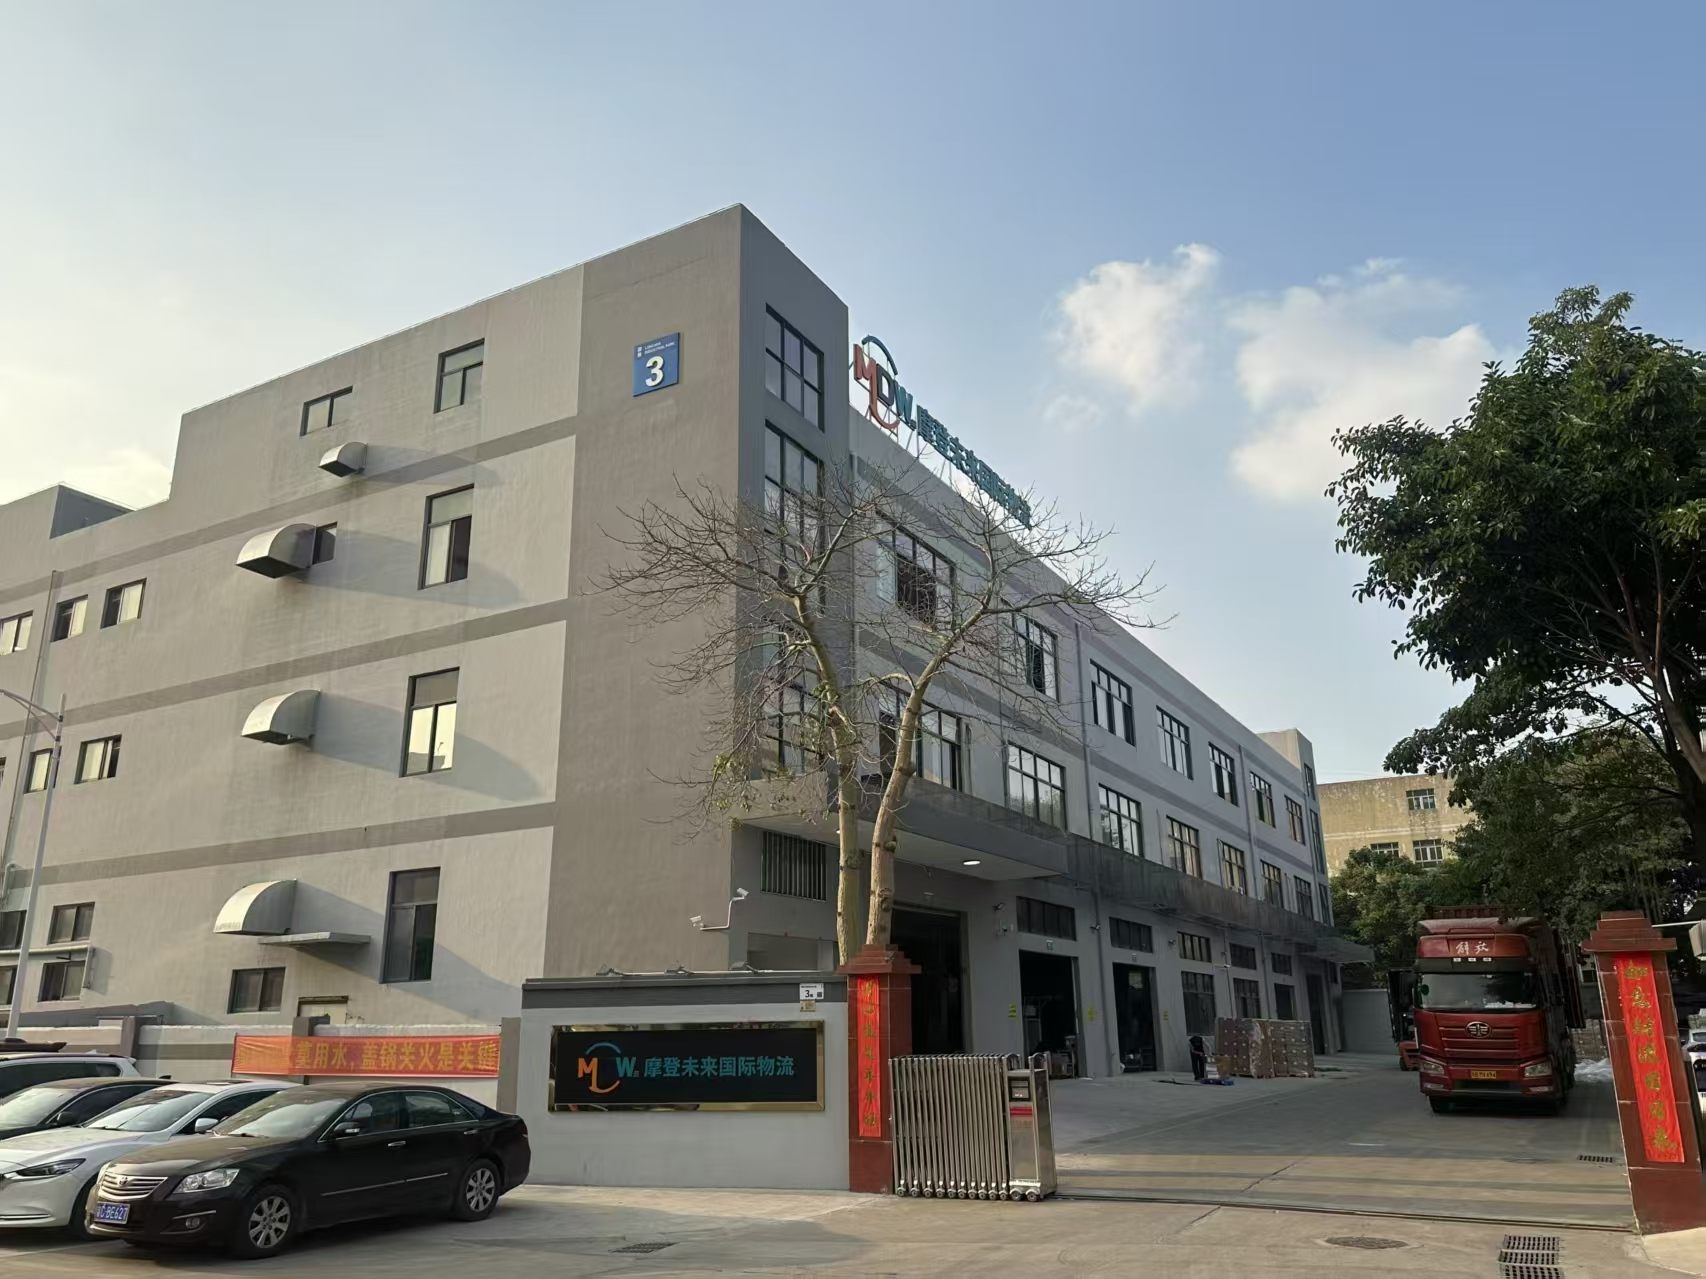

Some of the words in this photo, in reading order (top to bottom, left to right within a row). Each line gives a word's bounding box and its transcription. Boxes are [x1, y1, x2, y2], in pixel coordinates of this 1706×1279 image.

[645, 356, 664, 387] 3
[643, 1056, 795, 1078] 摩登未来国际物流
